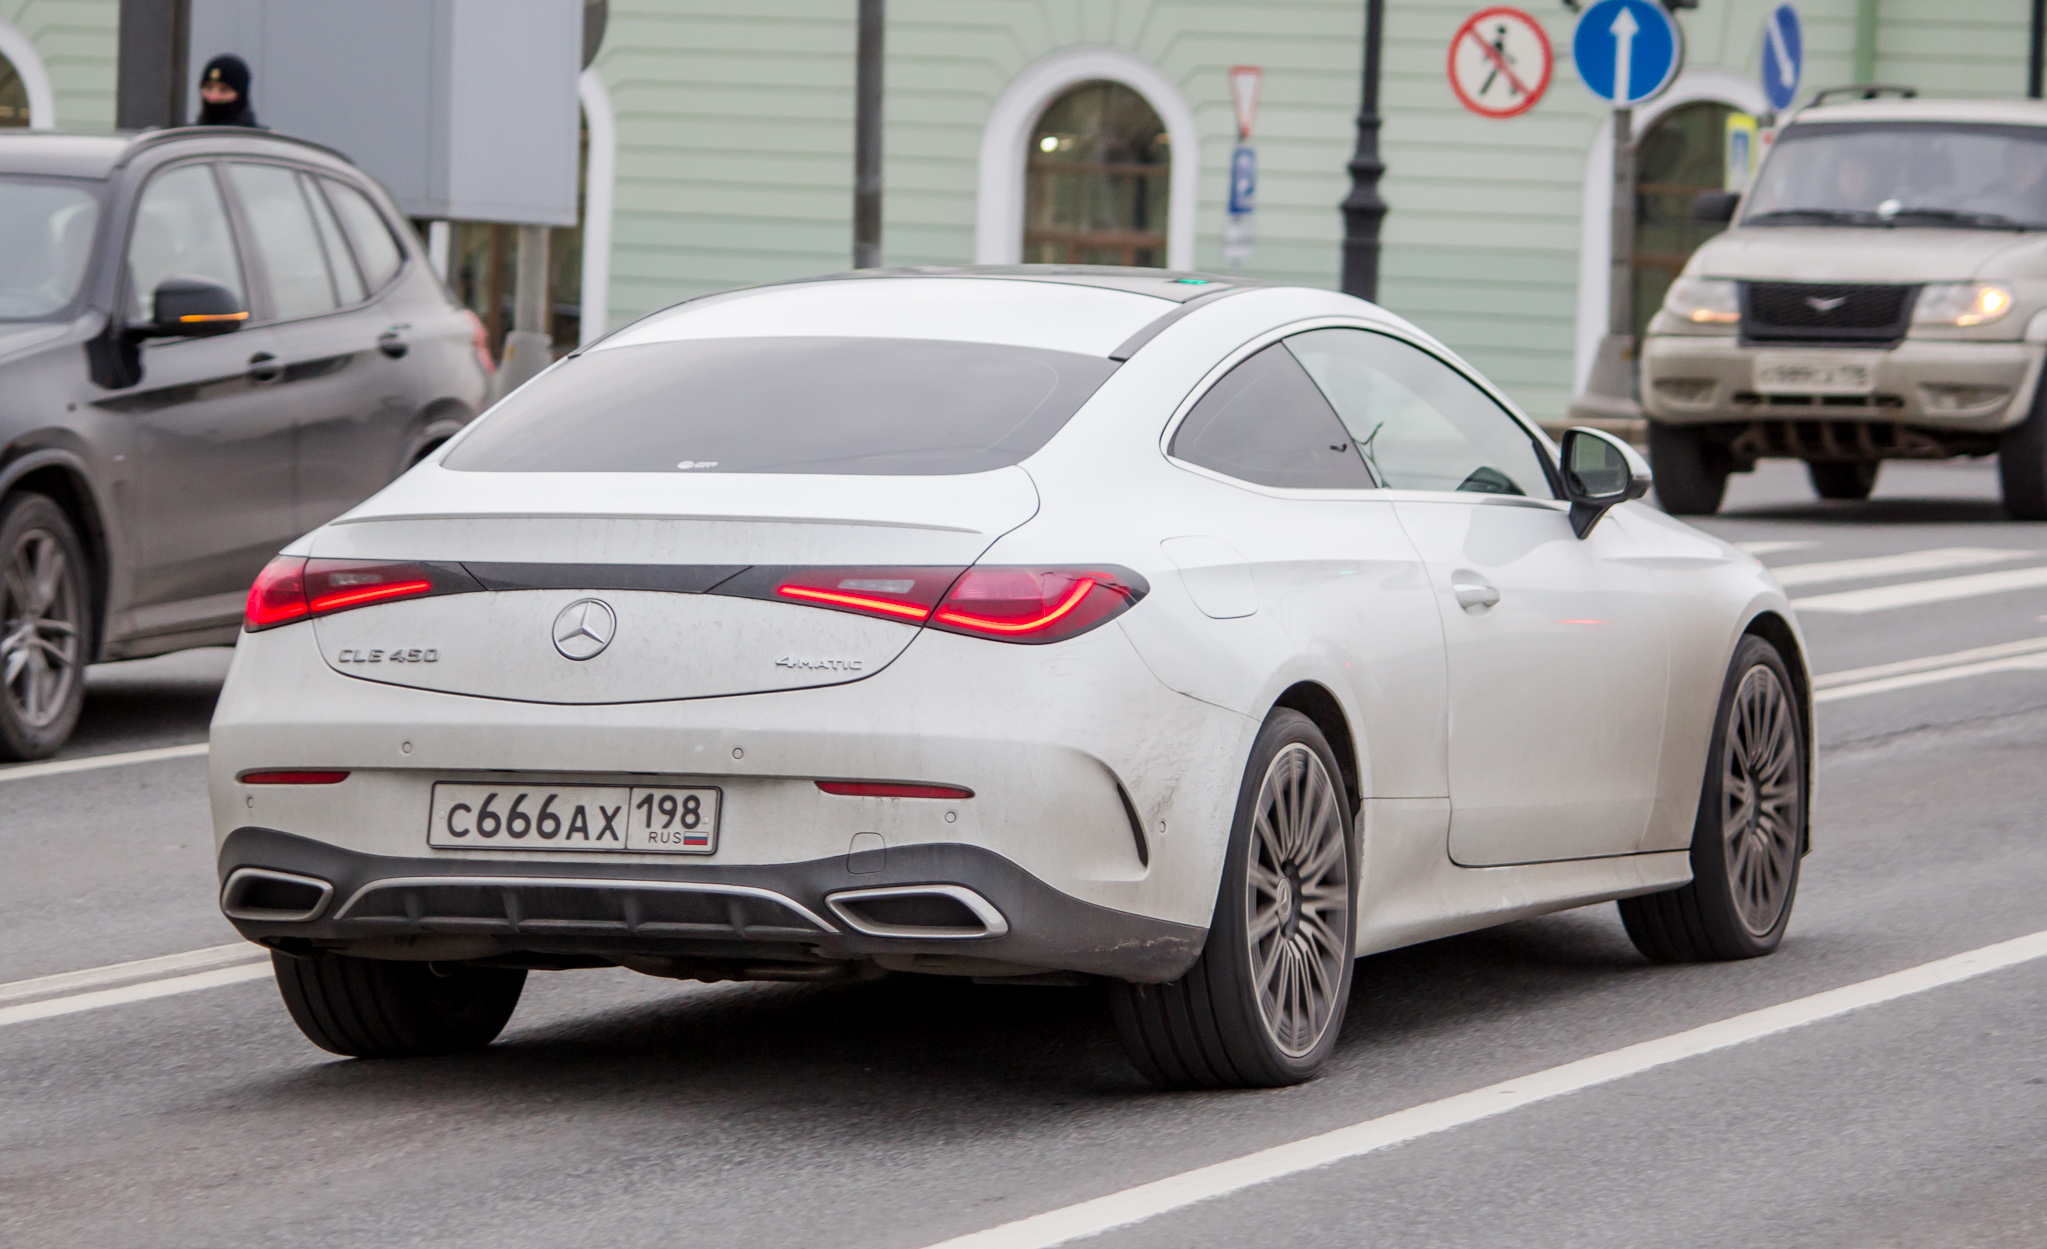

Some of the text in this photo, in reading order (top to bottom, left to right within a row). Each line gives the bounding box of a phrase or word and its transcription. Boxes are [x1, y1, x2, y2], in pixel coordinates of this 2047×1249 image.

[338, 648, 439, 663] CLE 450
[775, 654, 863, 671] 4MATIC
[636, 793, 701, 830] 198
[648, 831, 682, 844] RUS
